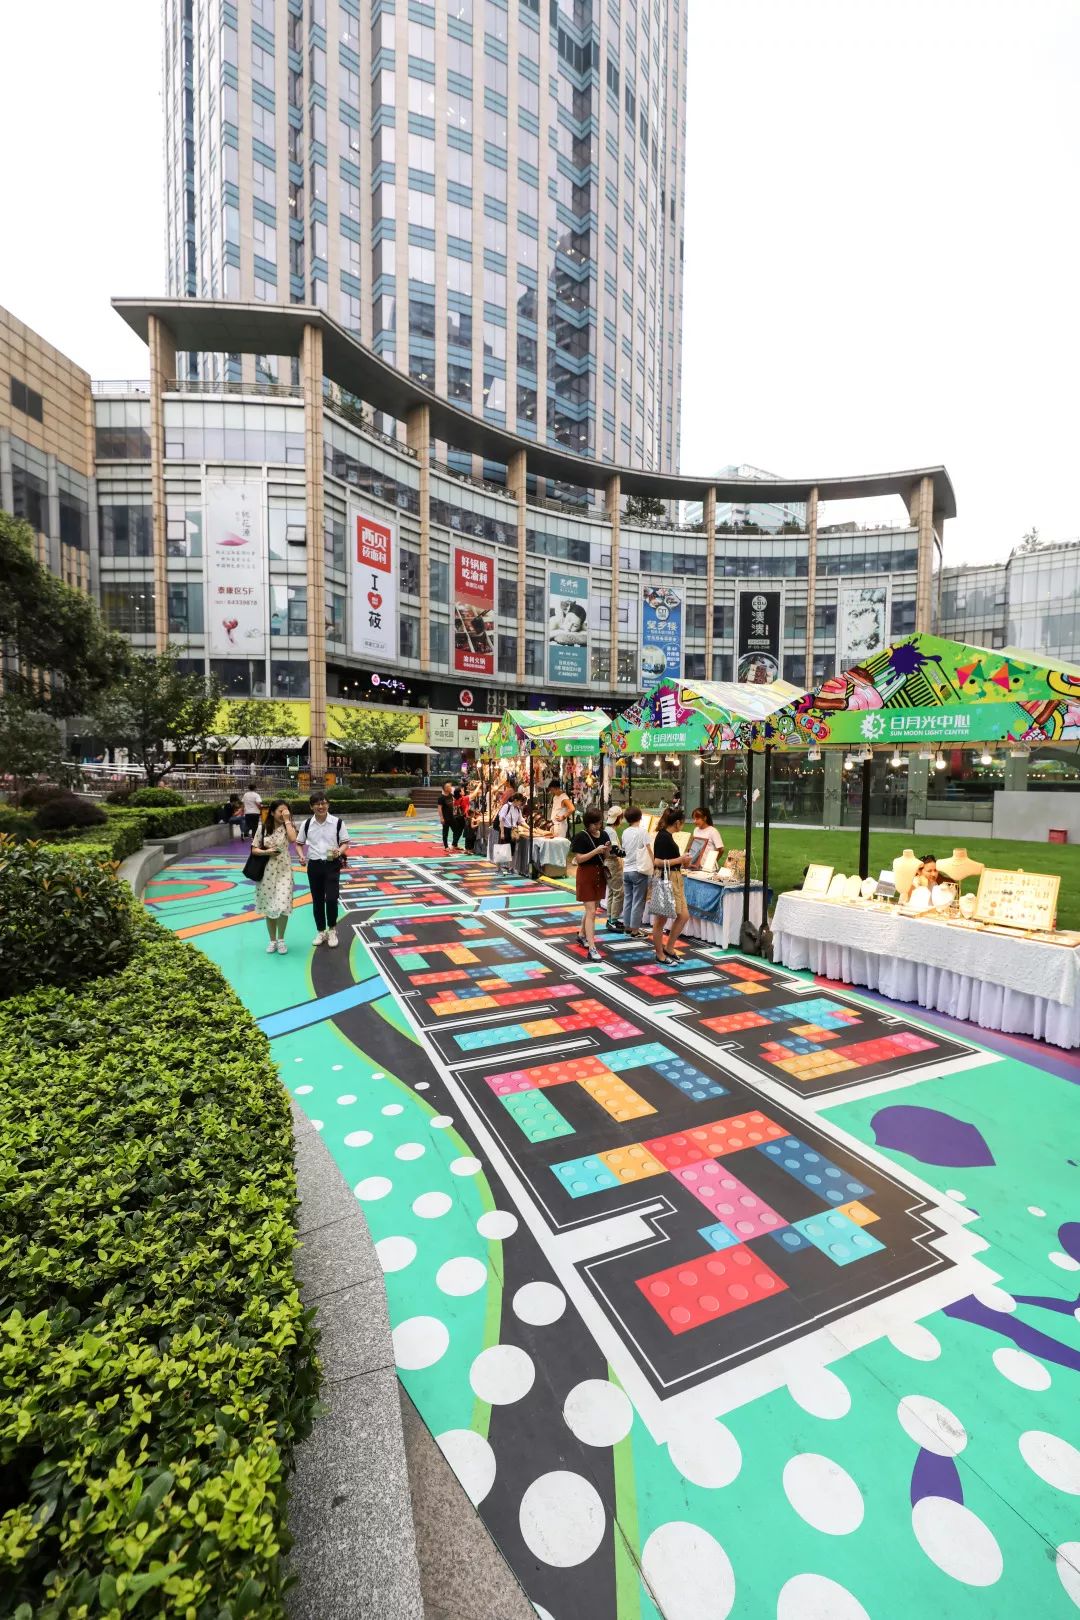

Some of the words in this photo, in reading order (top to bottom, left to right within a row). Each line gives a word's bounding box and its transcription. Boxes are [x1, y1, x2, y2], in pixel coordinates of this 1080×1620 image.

[361, 526, 387, 552] 西贝
[362, 546, 387, 565] 莜面村
[440, 719, 449, 727] 1F
[890, 714, 971, 730] 日月光中心
[653, 732, 686, 743] 日月光中心
